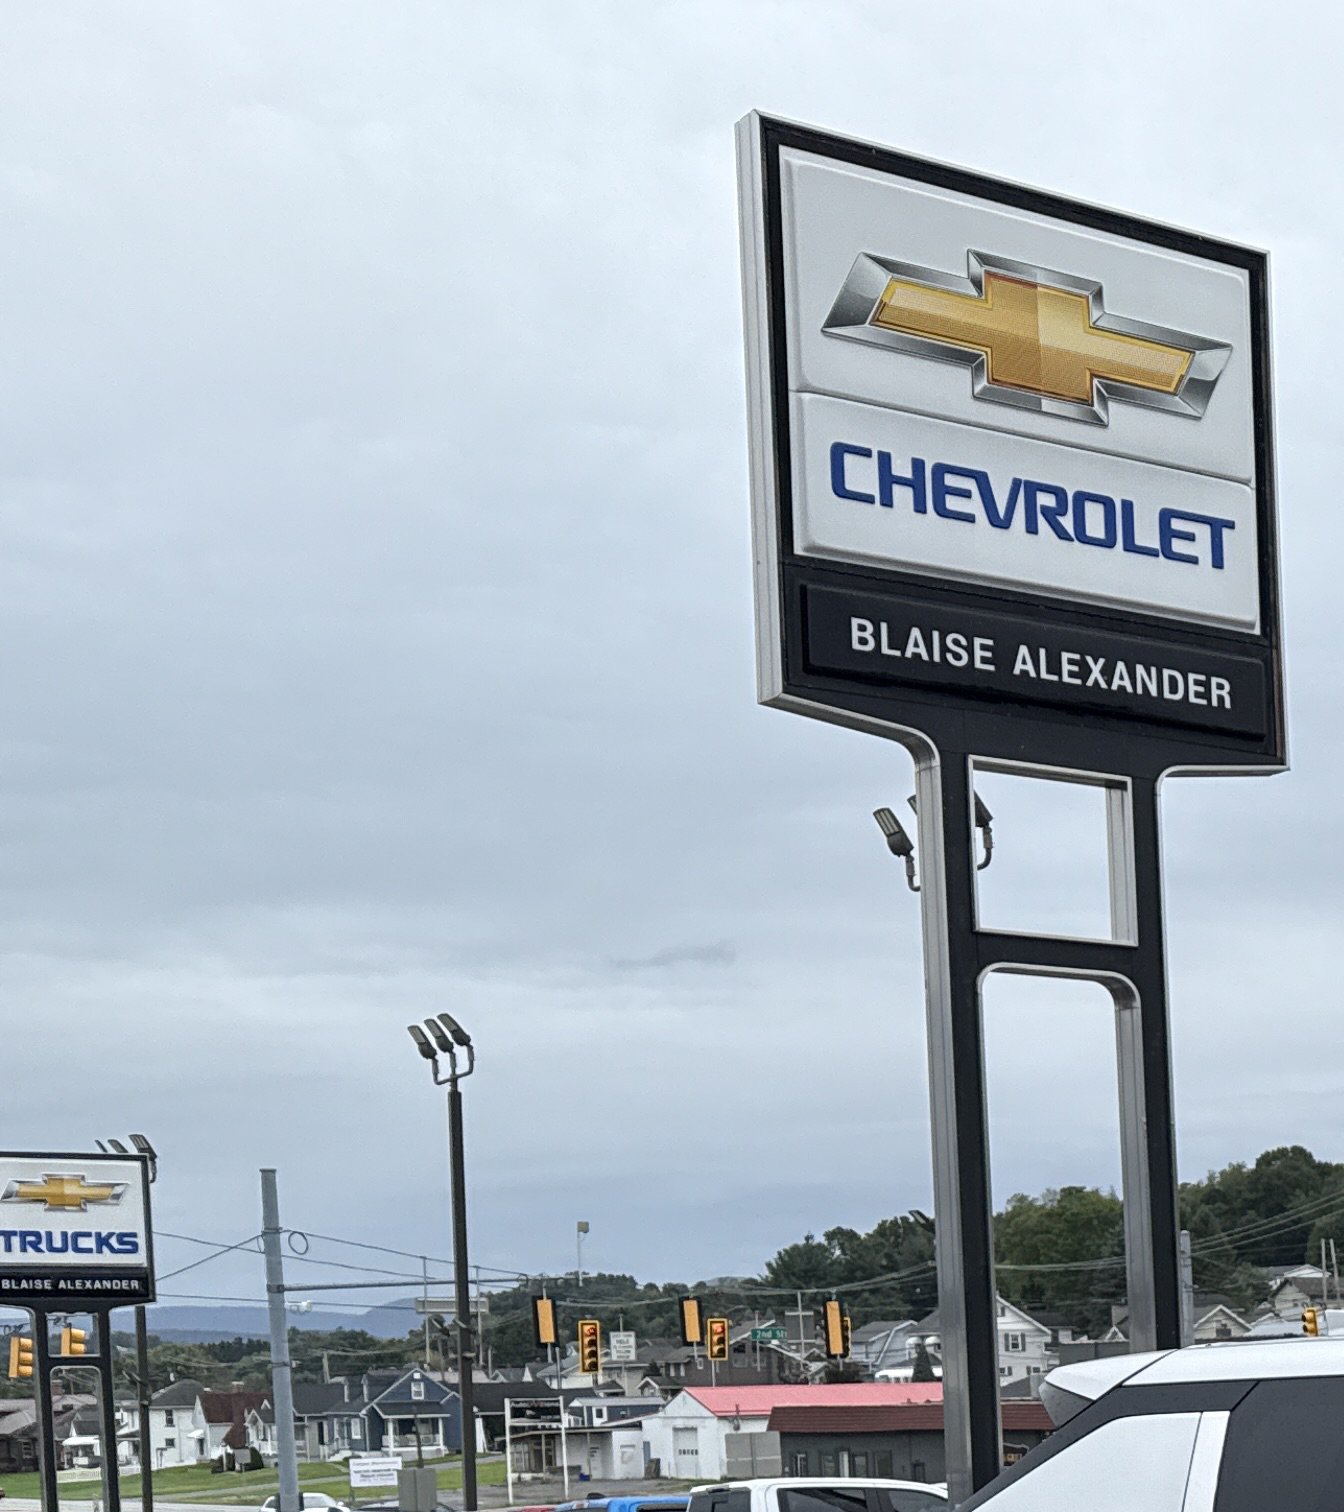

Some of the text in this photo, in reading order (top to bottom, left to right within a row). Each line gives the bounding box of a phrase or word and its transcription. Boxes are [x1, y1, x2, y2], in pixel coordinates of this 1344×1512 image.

[830, 441, 1236, 569] CHEVROLET
[850, 616, 1232, 709] BLAISE ALEXANDER
[0, 1230, 139, 1254] TRUCKS
[1, 1279, 139, 1290] BLAISE ALEXANDER
